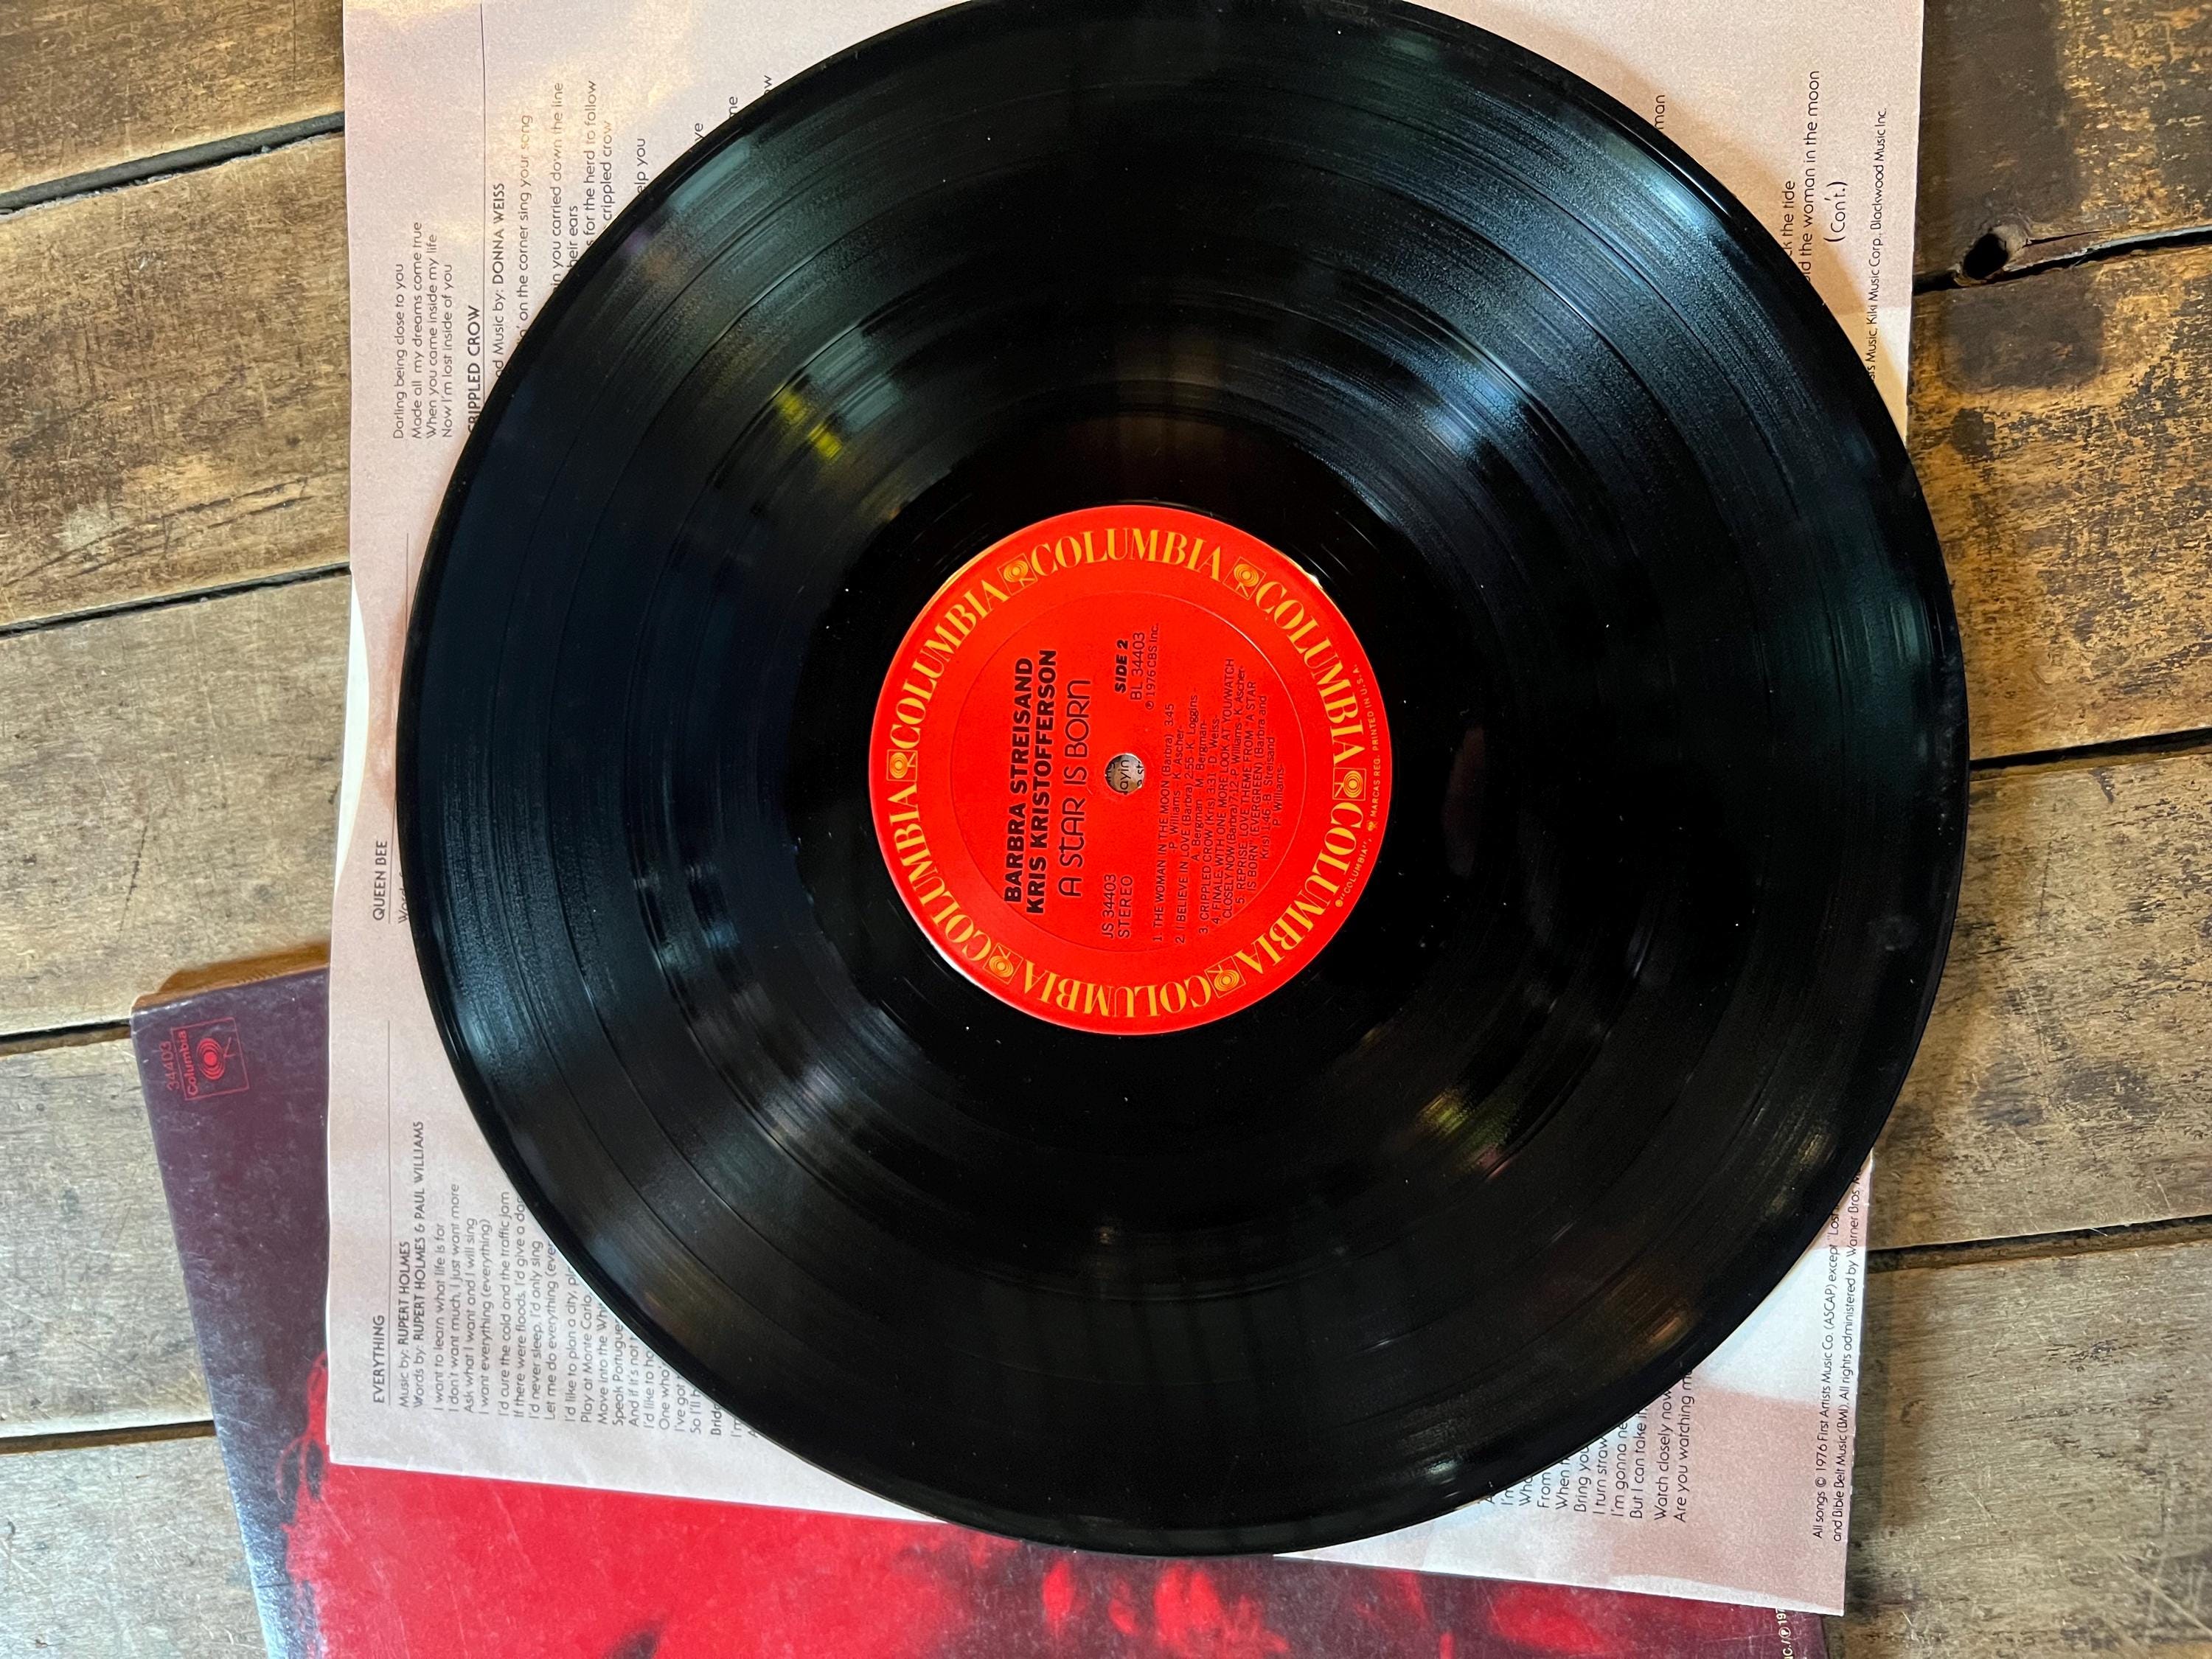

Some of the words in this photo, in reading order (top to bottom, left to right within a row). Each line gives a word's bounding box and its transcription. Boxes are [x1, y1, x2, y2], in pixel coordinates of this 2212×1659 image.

[1807, 71, 1819, 116] moon
[1874, 108, 1887, 126] Inc.
[519, 116, 533, 150] song
[1804, 122, 1818, 145] the
[1874, 130, 1885, 161] Music
[518, 154, 532, 187] your
[1804, 150, 1815, 163] in
[493, 183, 505, 223] WEISS
[518, 192, 532, 220] sing
[1782, 181, 1795, 209] tide
[1803, 168, 1815, 228] woman
[1871, 164, 1884, 229] Blackwood
[411, 223, 422, 248] true
[1781, 214, 1793, 236] the
[426, 234, 437, 253] life
[493, 229, 505, 284] DONNA
[518, 225, 529, 271] corner
[1800, 233, 1812, 256] the
[394, 264, 406, 290] you
[413, 253, 422, 291] come
[428, 257, 439, 280] my
[443, 265, 455, 290] you
[394, 295, 404, 307] to
[442, 294, 453, 307] of
[493, 290, 507, 310] by:
[516, 275, 529, 298] the
[1868, 270, 1879, 301] Music
[426, 285, 438, 323] inside
[518, 303, 529, 321] on
[1866, 305, 1877, 325] Kiki
[394, 312, 405, 345] close
[411, 296, 422, 347] dreams
[442, 312, 453, 350] inside
[468, 305, 481, 355] CROW
[493, 316, 504, 354] Music
[414, 351, 424, 374] my
[428, 328, 437, 366] came
[393, 349, 408, 387] being
[442, 355, 453, 378] lost
[411, 381, 422, 395] all
[428, 370, 440, 395] you
[442, 382, 453, 402] I'm
[468, 363, 481, 433] RIPPLED
[392, 392, 407, 439] Darling
[411, 399, 422, 439] Made
[426, 400, 437, 439] When
[442, 406, 453, 437] Now
[1032, 527, 1221, 581] COLUMBIA
[1116, 639, 1128, 650] 2
[1149, 623, 1159, 641] Inc.
[891, 580, 1009, 749] COLUMBIA
[1133, 633, 1144, 677] 34403
[1147, 645, 1157, 668] CBS
[1115, 655, 1127, 693] SIDE
[1146, 669, 1156, 697] 1976
[1256, 581, 1365, 765] COLUMBIA
[1130, 681, 1143, 700] BL
[1364, 698, 1373, 708] IN
[1010, 658, 1032, 794] STREISAND
[1164, 703, 1175, 726] 3:45
[1367, 711, 1379, 751] PRINTED
[1030, 650, 1056, 848] KRISTOFFERSON
[1161, 734, 1173, 776] (Barbra)
[1063, 766, 1087, 785] IS
[1160, 781, 1169, 814] MOON
[1206, 798, 1215, 825] (Kris)
[1370, 780, 1381, 817] MARCAS
[1158, 818, 1168, 839] THE
[375, 841, 387, 865] BEE
[1004, 802, 1026, 902] BARBRA
[1158, 844, 1166, 855] IN
[1203, 830, 1213, 862] CROW
[887, 784, 992, 961] COLUMBIA
[1026, 857, 1046, 914] KRIS
[1059, 877, 1082, 897] A
[1155, 860, 1166, 902] WOMAN
[1233, 801, 1364, 974] COLUMBIA
[373, 870, 386, 921] QUEEN
[1104, 874, 1116, 918] 34403
[1119, 875, 1133, 939] STEREO
[1200, 866, 1211, 920] CRIPPLED
[1102, 923, 1113, 939] JS
[1153, 906, 1164, 928] THE
[1024, 959, 1211, 1018] COLUMBIA
[159, 1040, 180, 1091] 34403
[178, 1030, 198, 1096] Columbia
[413, 1121, 424, 1183] WILLIAMS
[414, 1189, 424, 1219] PAUL
[1848, 1188, 1860, 1213] Bros.
[414, 1223, 424, 1232] &
[434, 1223, 444, 1241] for
[1846, 1216, 1858, 1256] Warner
[415, 1237, 425, 1290] HOLMES
[434, 1245, 444, 1253] is
[1827, 1244, 1839, 1281] except
[399, 1242, 410, 1294] HOLMES
[434, 1258, 444, 1276] life
[1846, 1260, 1859, 1276] by
[434, 1280, 444, 1312] what
[1823, 1284, 1836, 1329] (ASCAP)
[399, 1299, 409, 1345] RUPERT
[414, 1295, 425, 1340] RUPERT
[1842, 1279, 1857, 1351] administered
[434, 1318, 444, 1350] learn
[1823, 1332, 1834, 1350] Co.
[373, 1315, 385, 1403] EVERYTHING
[399, 1349, 410, 1368] by:
[414, 1345, 425, 1363] by:
[434, 1354, 443, 1366] to
[1820, 1353, 1833, 1382] Music
[1839, 1354, 1854, 1383] rights
[399, 1373, 408, 1408] Music
[414, 1368, 424, 1408] Words
[435, 1371, 444, 1402] want
[1819, 1386, 1832, 1417] Artists
[1838, 1387, 1849, 1400] All
[1661, 1389, 1672, 1419] now
[1633, 1423, 1646, 1453] take
[1677, 1396, 1694, 1460] watching
[1817, 1420, 1829, 1441] First
[1658, 1424, 1673, 1472] closely
[1816, 1444, 1828, 1472] 1976
[1835, 1436, 1847, 1465] Music
[1633, 1458, 1644, 1484] can
[1676, 1466, 1689, 1492] you
[1834, 1468, 1845, 1488] Belt
[1630, 1496, 1643, 1519] But
[1654, 1477, 1669, 1520] Watch
[1673, 1497, 1686, 1523] Are
[1815, 1491, 1828, 1522] songs
[1832, 1492, 1844, 1517] Bible
[1812, 1525, 1823, 1538] All
[1832, 1520, 1842, 1542] and
